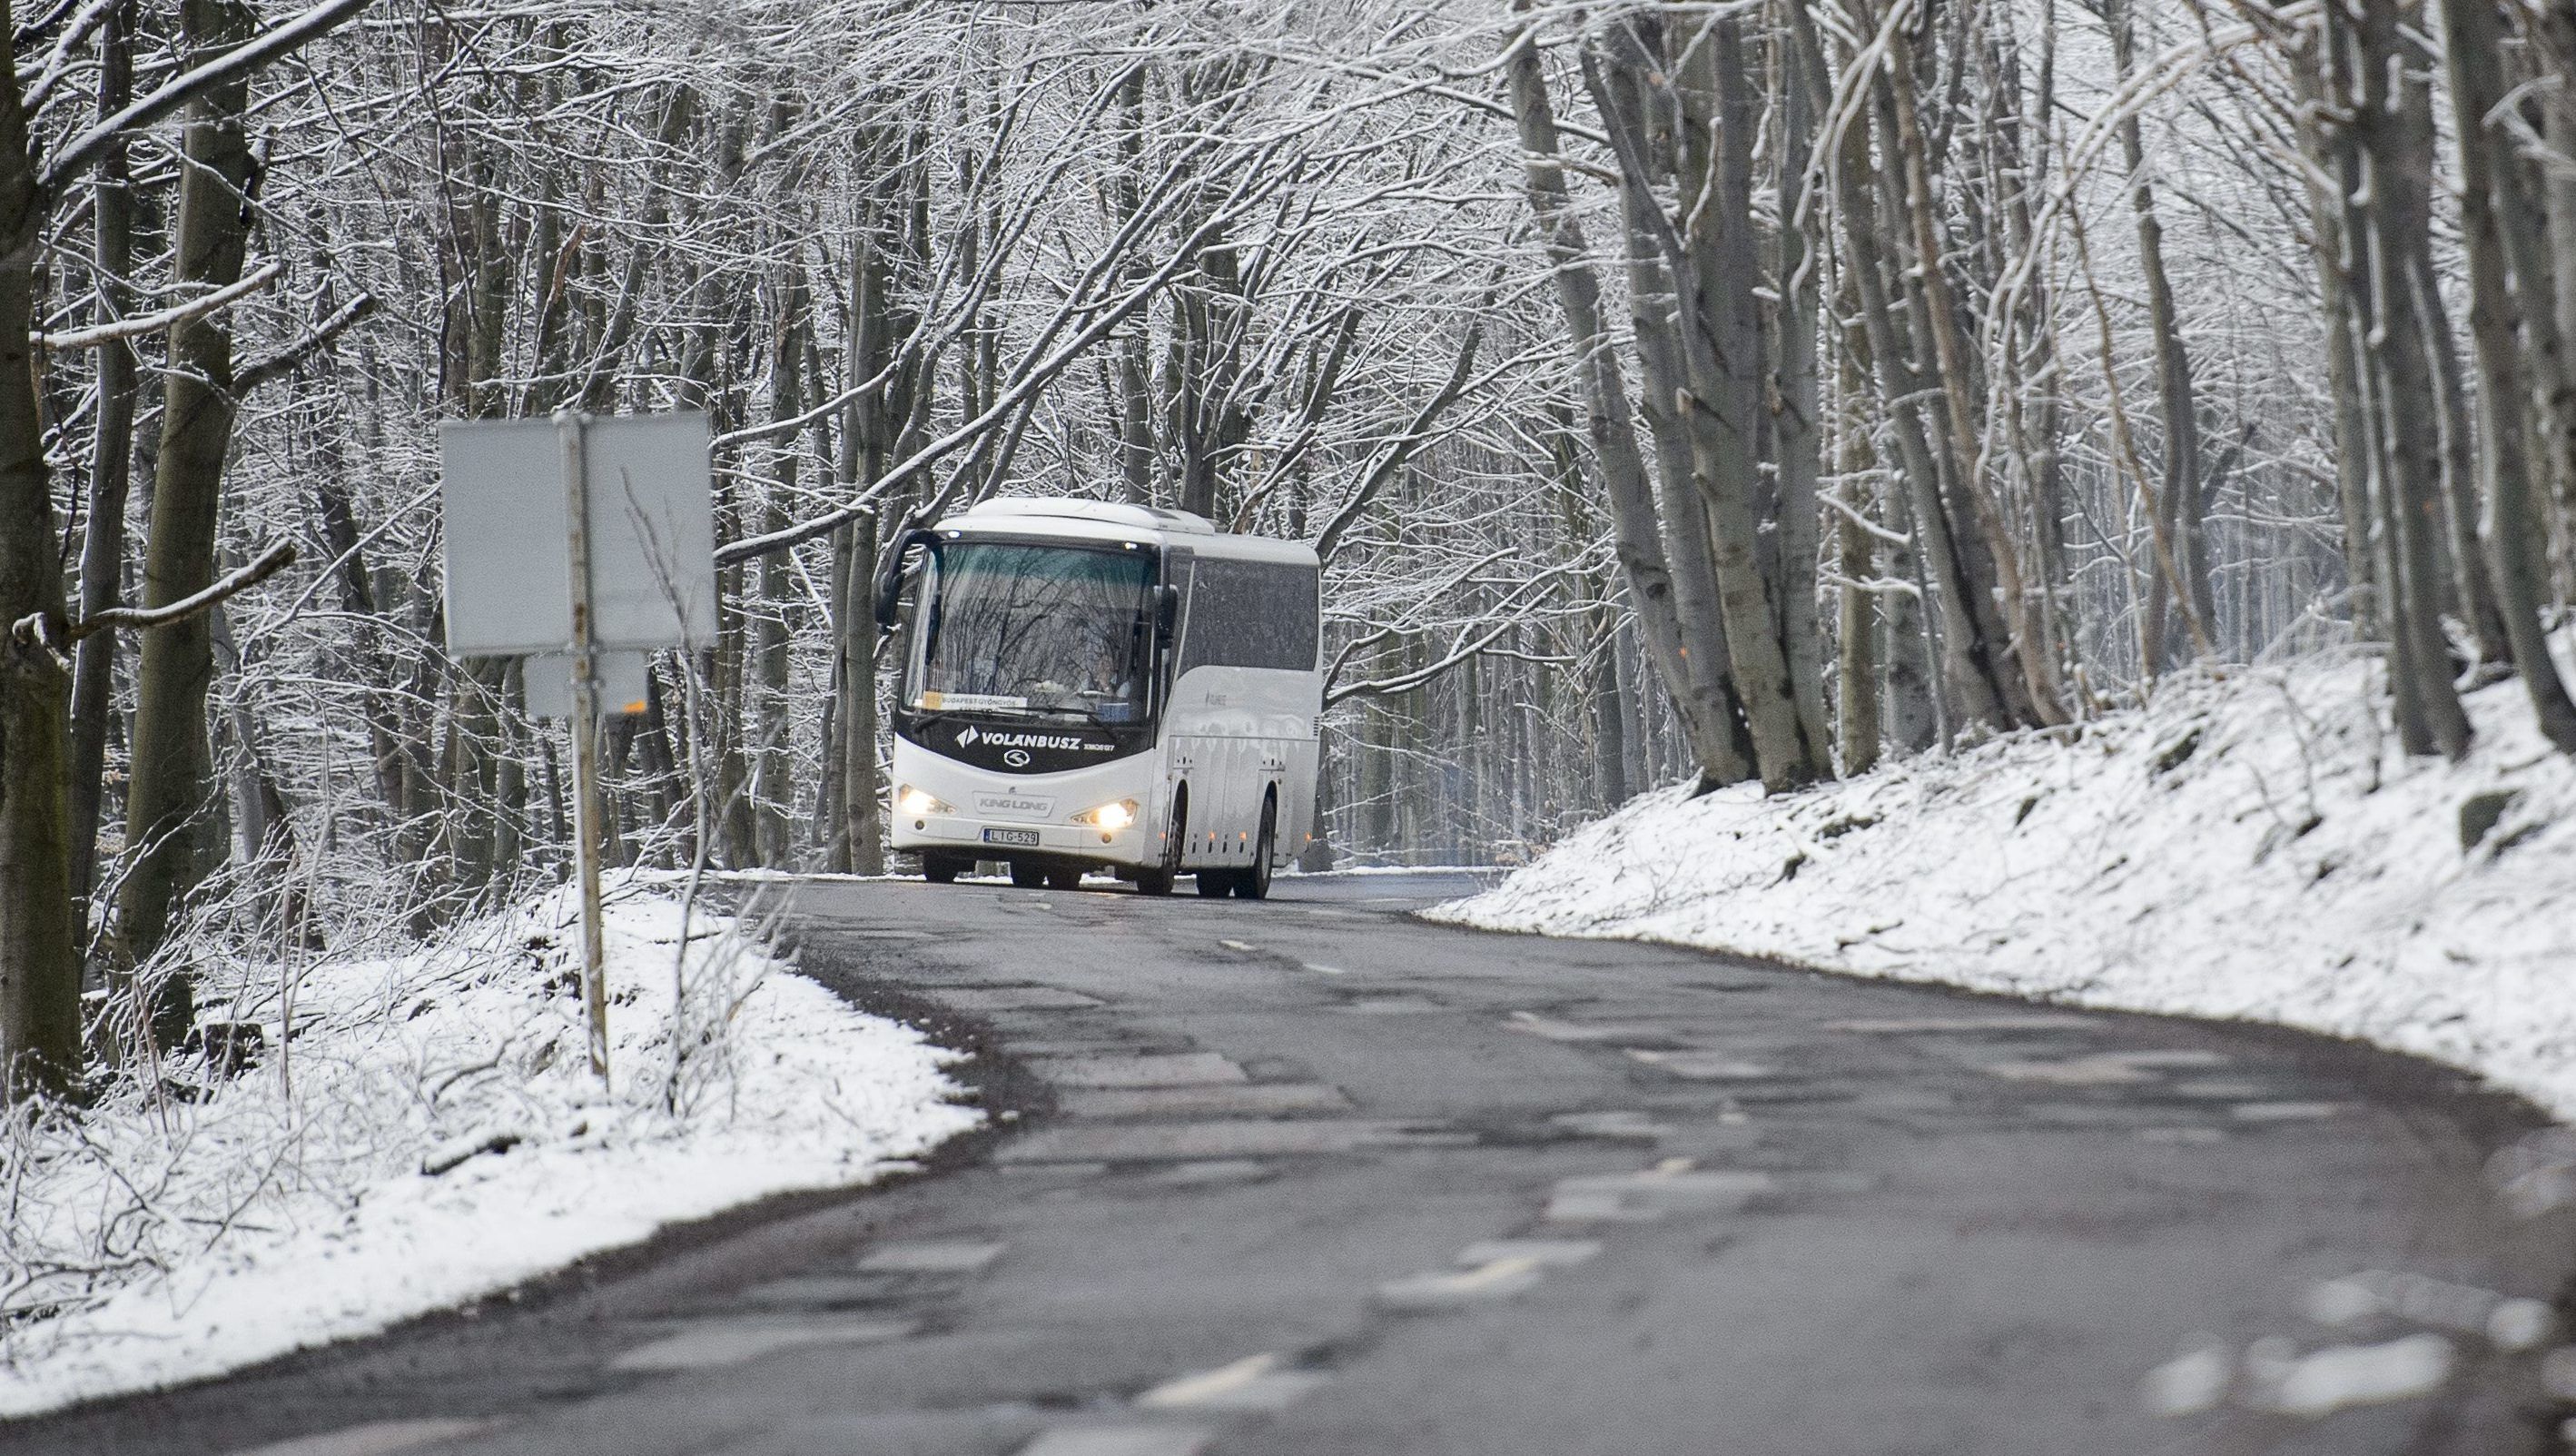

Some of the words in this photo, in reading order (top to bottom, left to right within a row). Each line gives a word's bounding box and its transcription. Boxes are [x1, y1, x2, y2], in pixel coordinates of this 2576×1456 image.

[980, 798, 1011, 808] KING
[1012, 801, 1048, 811] LONG
[991, 830, 1036, 843] LIG-529
